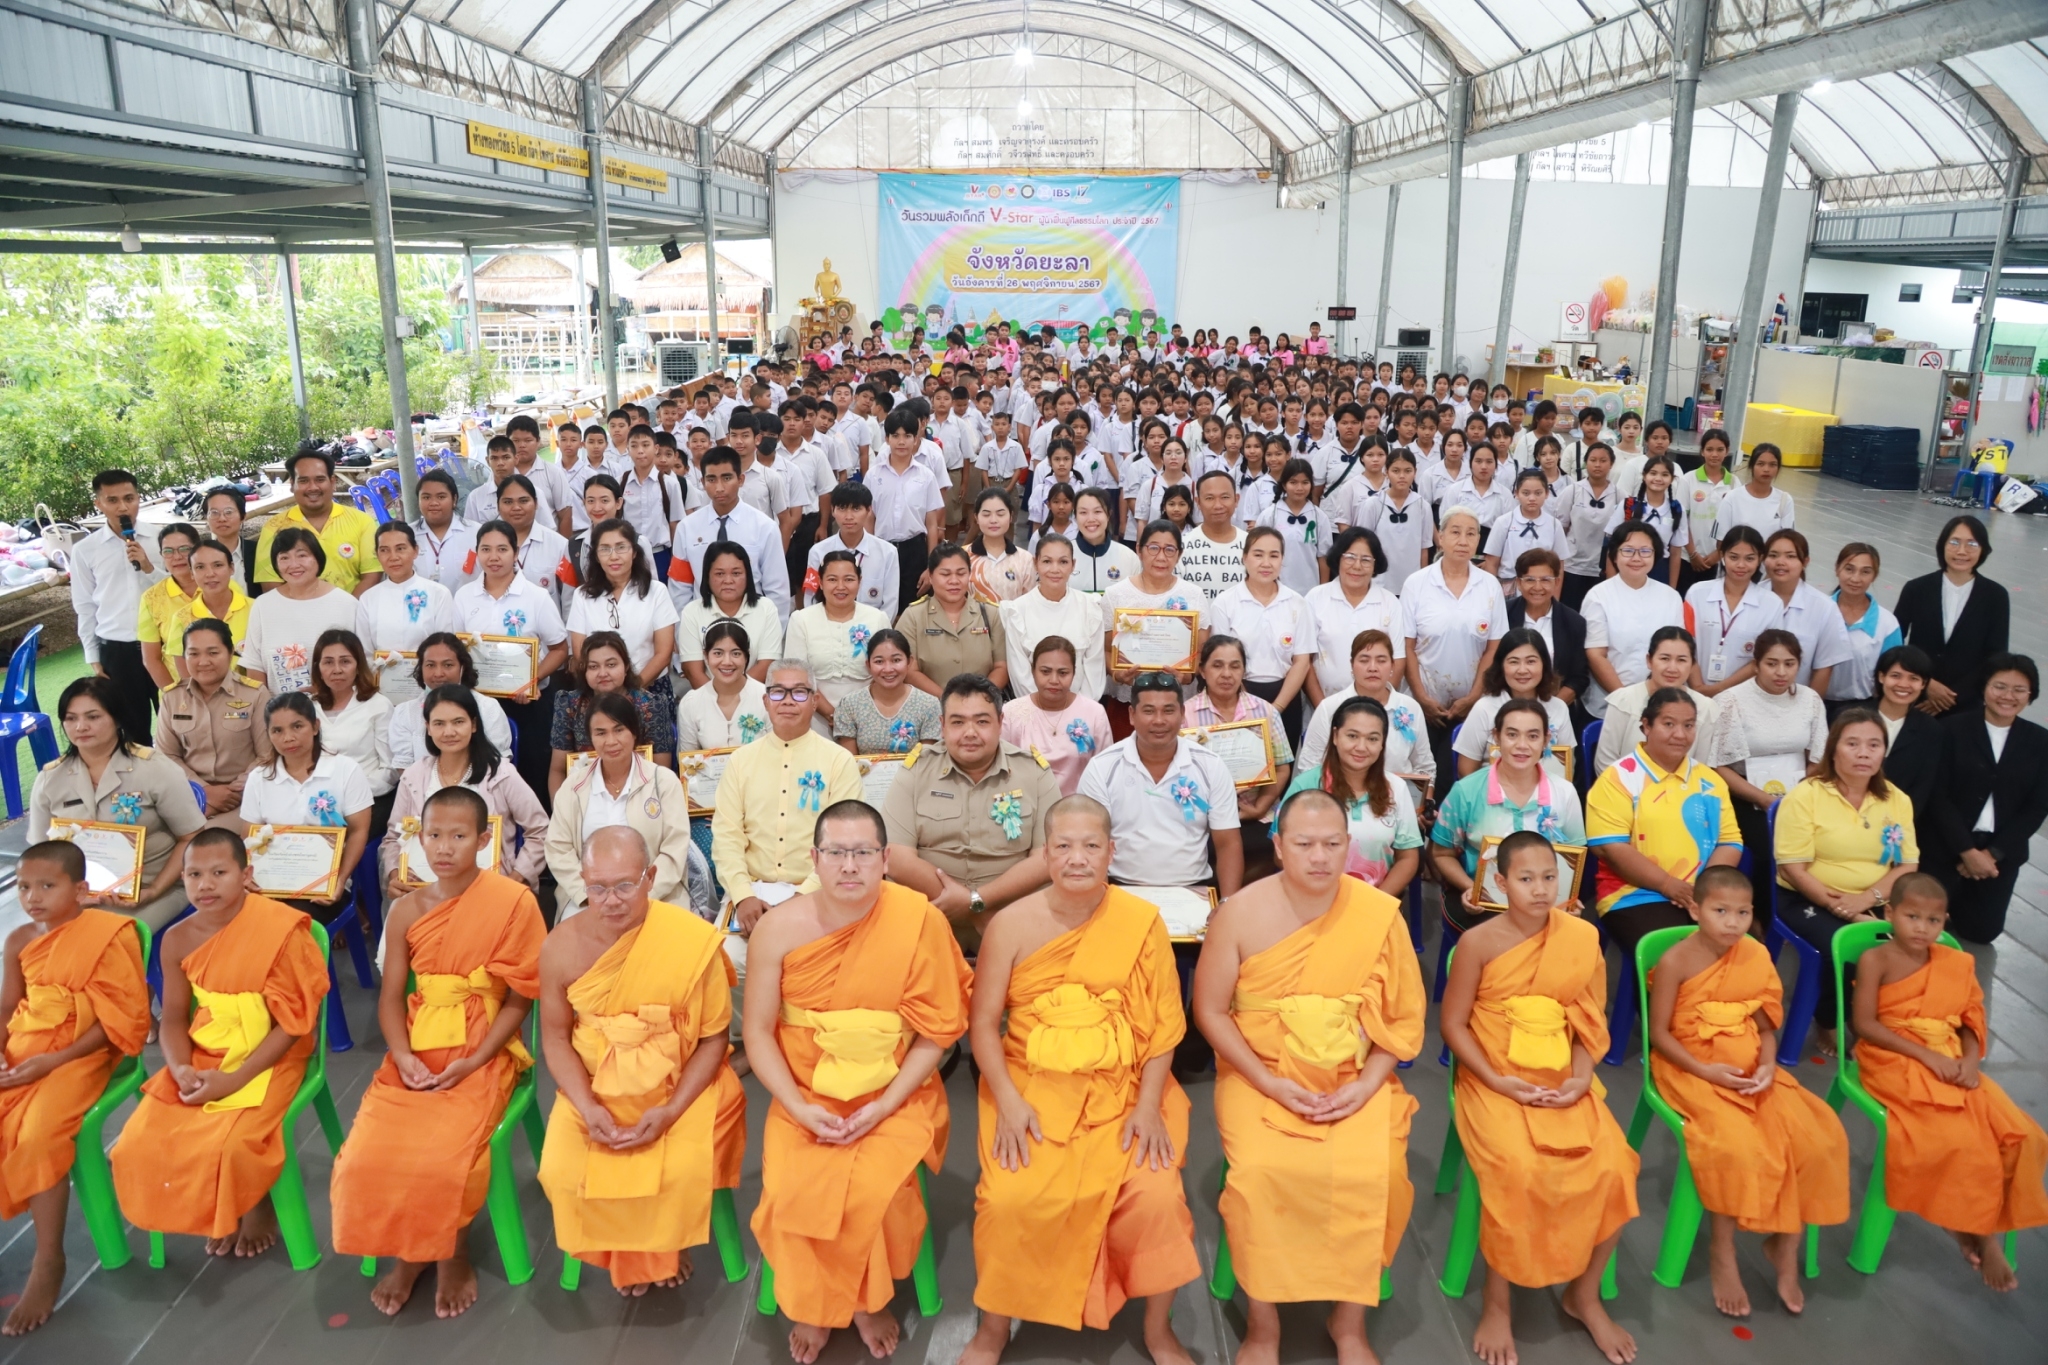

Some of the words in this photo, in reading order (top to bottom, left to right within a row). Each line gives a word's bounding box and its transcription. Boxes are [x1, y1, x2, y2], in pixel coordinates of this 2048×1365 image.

[1053, 189, 1070, 197] IBS
[901, 208, 985, 222] วันรวมพลังเด็กดี
[1140, 217, 1160, 226] 2567
[967, 247, 1090, 271] จังหวัดยะลา
[951, 274, 1004, 287] วันอังคารที่
[1006, 279, 1018, 287] 26
[1021, 277, 1075, 291] พฤศจิกายน
[1078, 279, 1101, 288] 2567
[1181, 554, 1245, 567] BALENCIA
